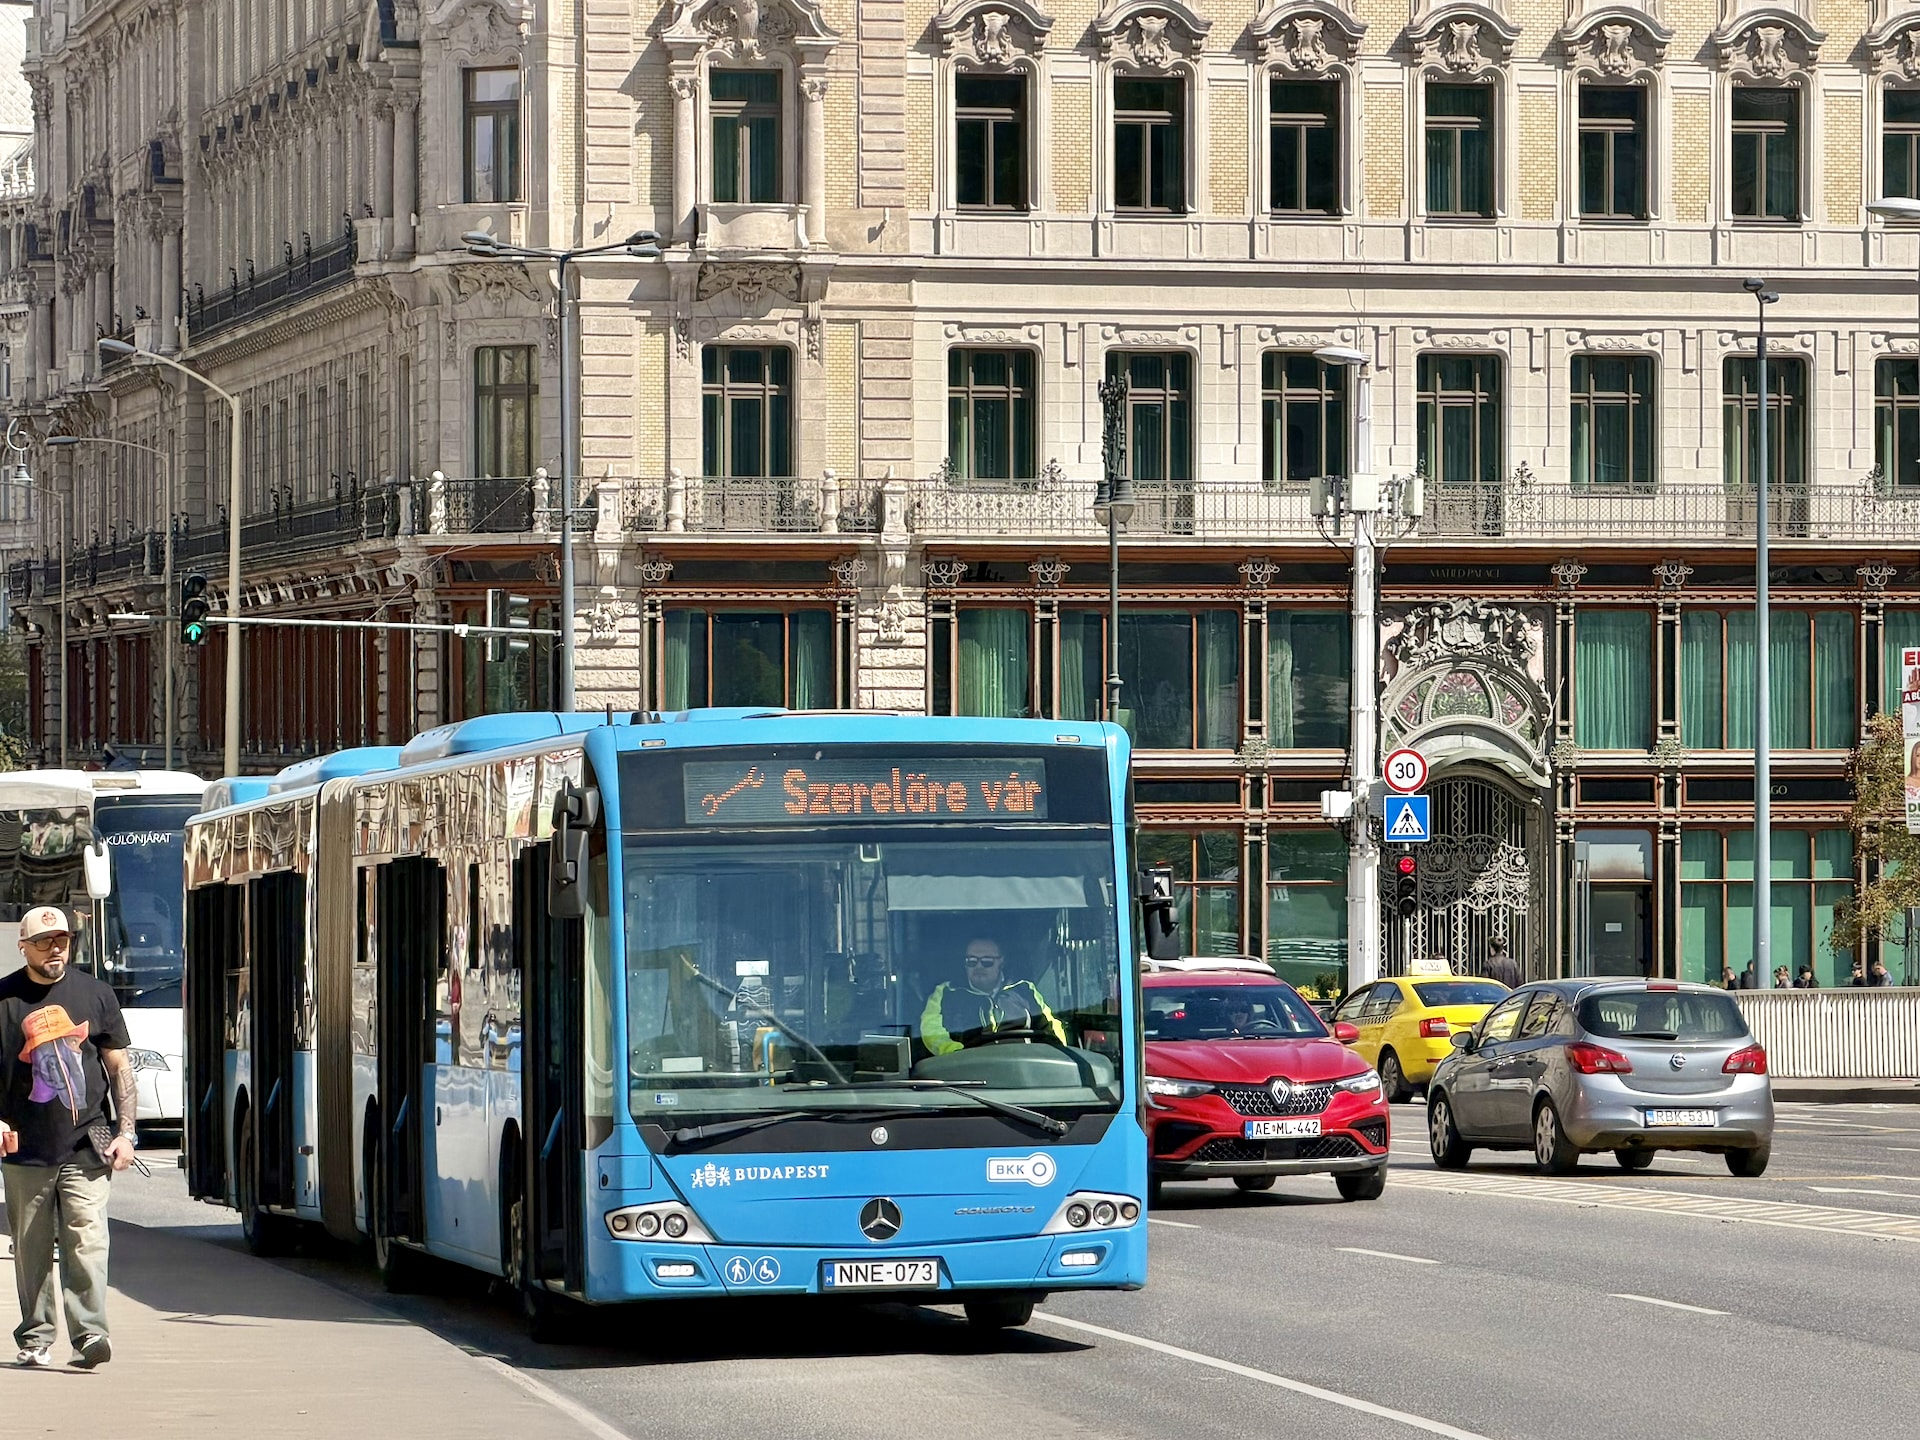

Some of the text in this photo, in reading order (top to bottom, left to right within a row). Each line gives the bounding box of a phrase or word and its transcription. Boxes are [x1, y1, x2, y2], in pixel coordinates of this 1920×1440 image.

[1904, 651, 1920, 666] E
[1395, 762, 1416, 779] 30
[981, 772, 1042, 812] vár
[1908, 802, 1920, 814] D
[734, 1165, 830, 1181] BUDAPEST
[996, 1164, 1025, 1175] BKK
[839, 1263, 933, 1284] NNE-073
